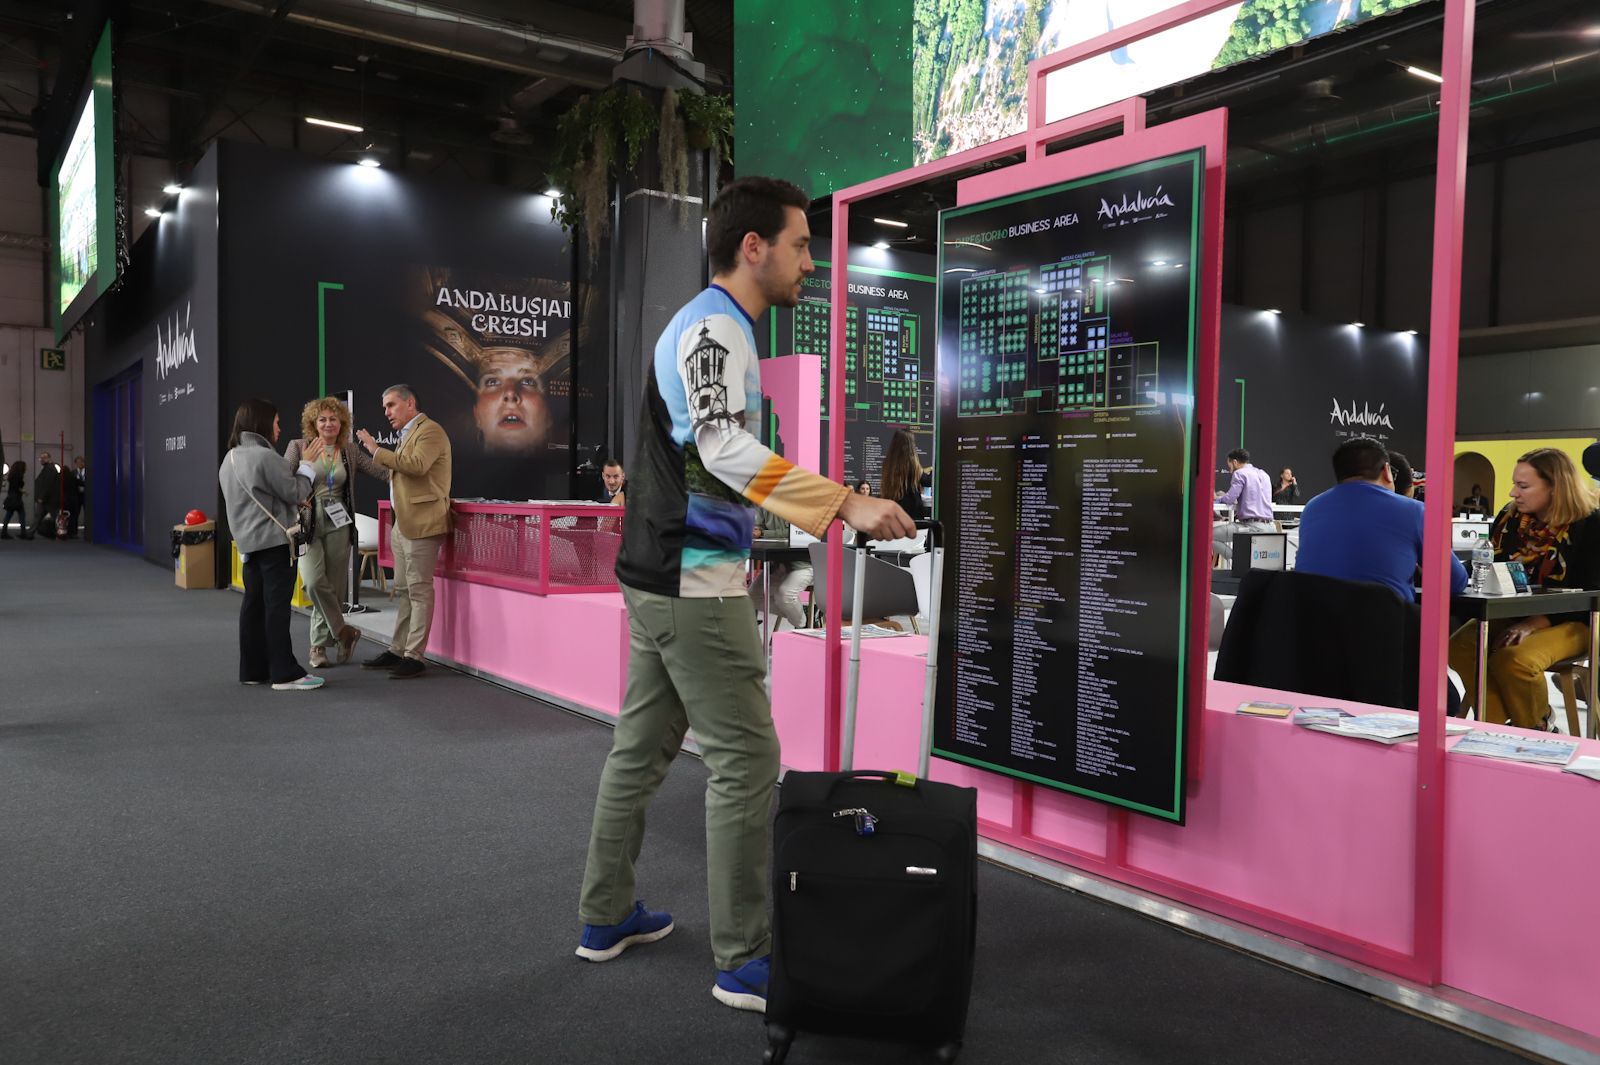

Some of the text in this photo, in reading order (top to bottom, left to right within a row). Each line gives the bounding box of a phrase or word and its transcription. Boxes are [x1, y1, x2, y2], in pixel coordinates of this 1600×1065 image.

[1008, 218, 1051, 238] BUSINESS
[1053, 213, 1079, 228] AREA
[848, 283, 886, 298] BUSINESS
[887, 289, 909, 300] AREA
[471, 314, 547, 338] CRUSH
[1329, 397, 1394, 430] Andalucía
